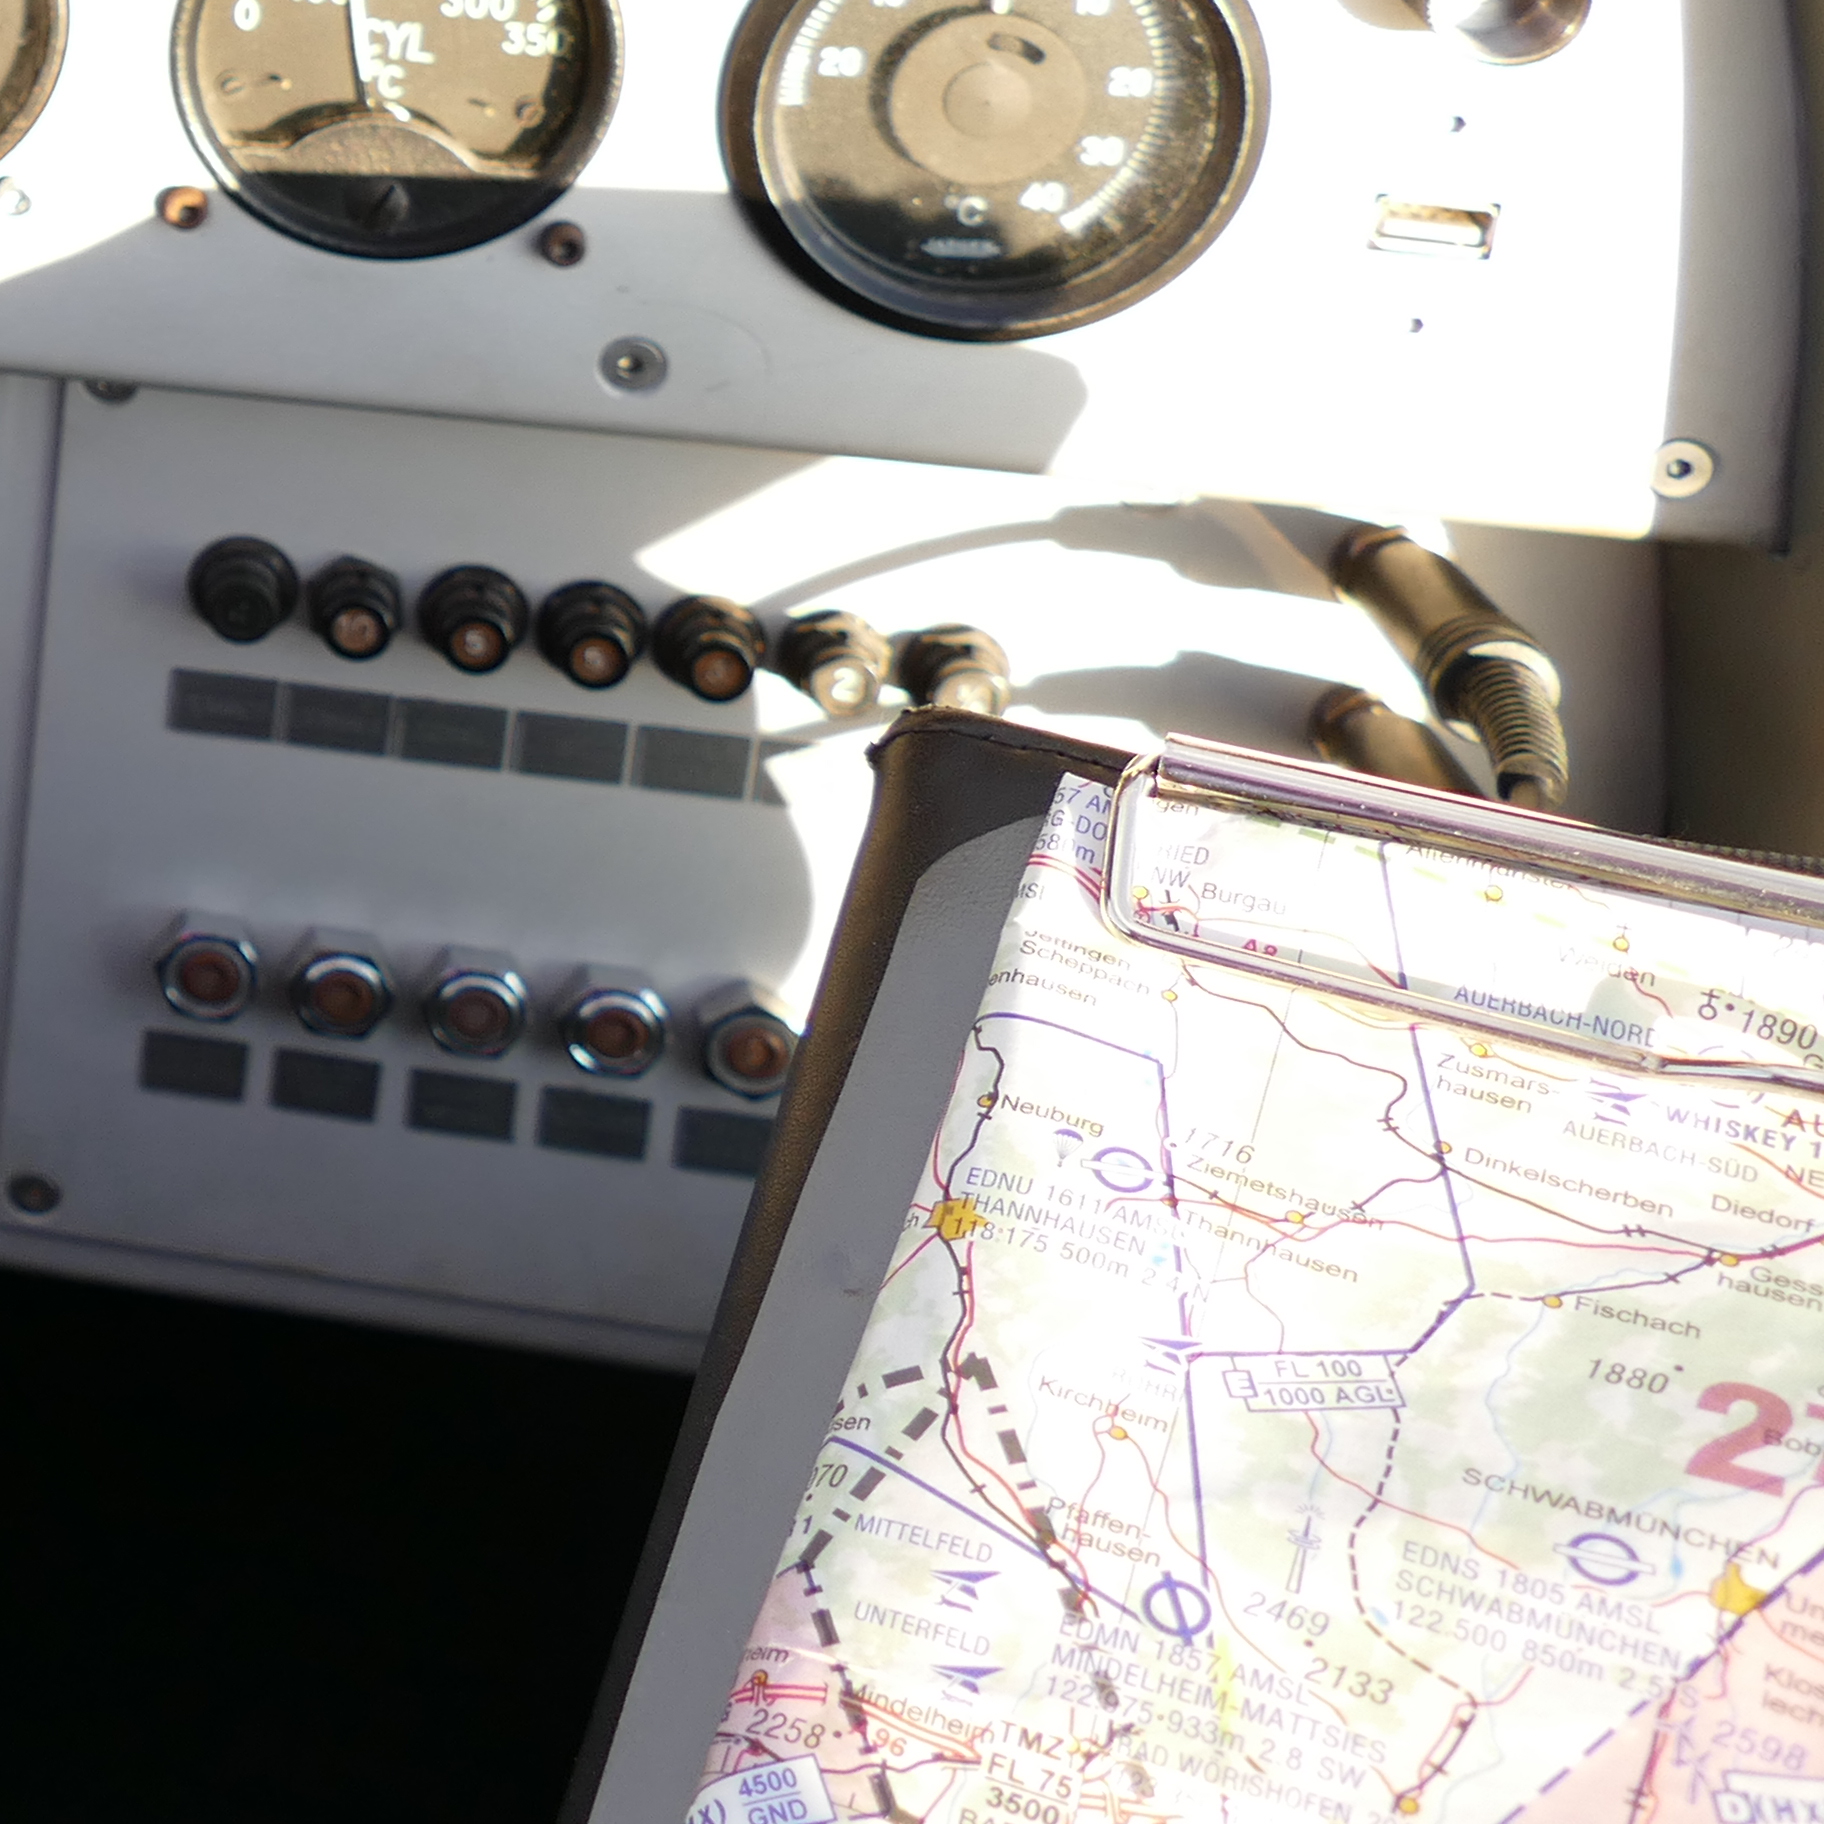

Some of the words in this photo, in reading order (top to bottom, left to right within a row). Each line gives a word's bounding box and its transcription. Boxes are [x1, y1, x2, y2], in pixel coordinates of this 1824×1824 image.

[1201, 882, 1287, 917] Burgau
[1741, 1009, 1818, 1050] 1890
[1001, 1093, 1105, 1137] Neuburg
[1436, 1073, 1534, 1114] hausen
[1666, 1105, 1798, 1153] WHISKEY
[965, 1167, 1035, 1197] EDNU
[1185, 1153, 1385, 1232] Ziemetshausen
[1464, 1147, 1675, 1220] Dinkelscherben
[958, 1190, 1147, 1257] THANNHAUSEN
[1711, 1192, 1818, 1232] Diedorf
[1717, 1271, 1824, 1313] hausen
[1573, 1295, 1702, 1341] Fischach
[1586, 1357, 1669, 1396] 1880
[1038, 1374, 1169, 1435] Kirchheim
[854, 1512, 994, 1565] MITTELFELD
[1461, 1467, 1781, 1571] SCHWABMÜNCHEN
[1061, 1523, 1162, 1568] hausen
[1401, 1539, 1480, 1582] EDNS
[853, 1599, 991, 1657] UNTERFELD
[1242, 1591, 1331, 1638] 2469
[1394, 1568, 1682, 1672] SCHWABMÜNCHEN
[1303, 1655, 1395, 1706] 2133
[744, 1706, 827, 1751] 2258
[1000, 1718, 1068, 1763] TMZ
[738, 1767, 799, 1798] 4500
